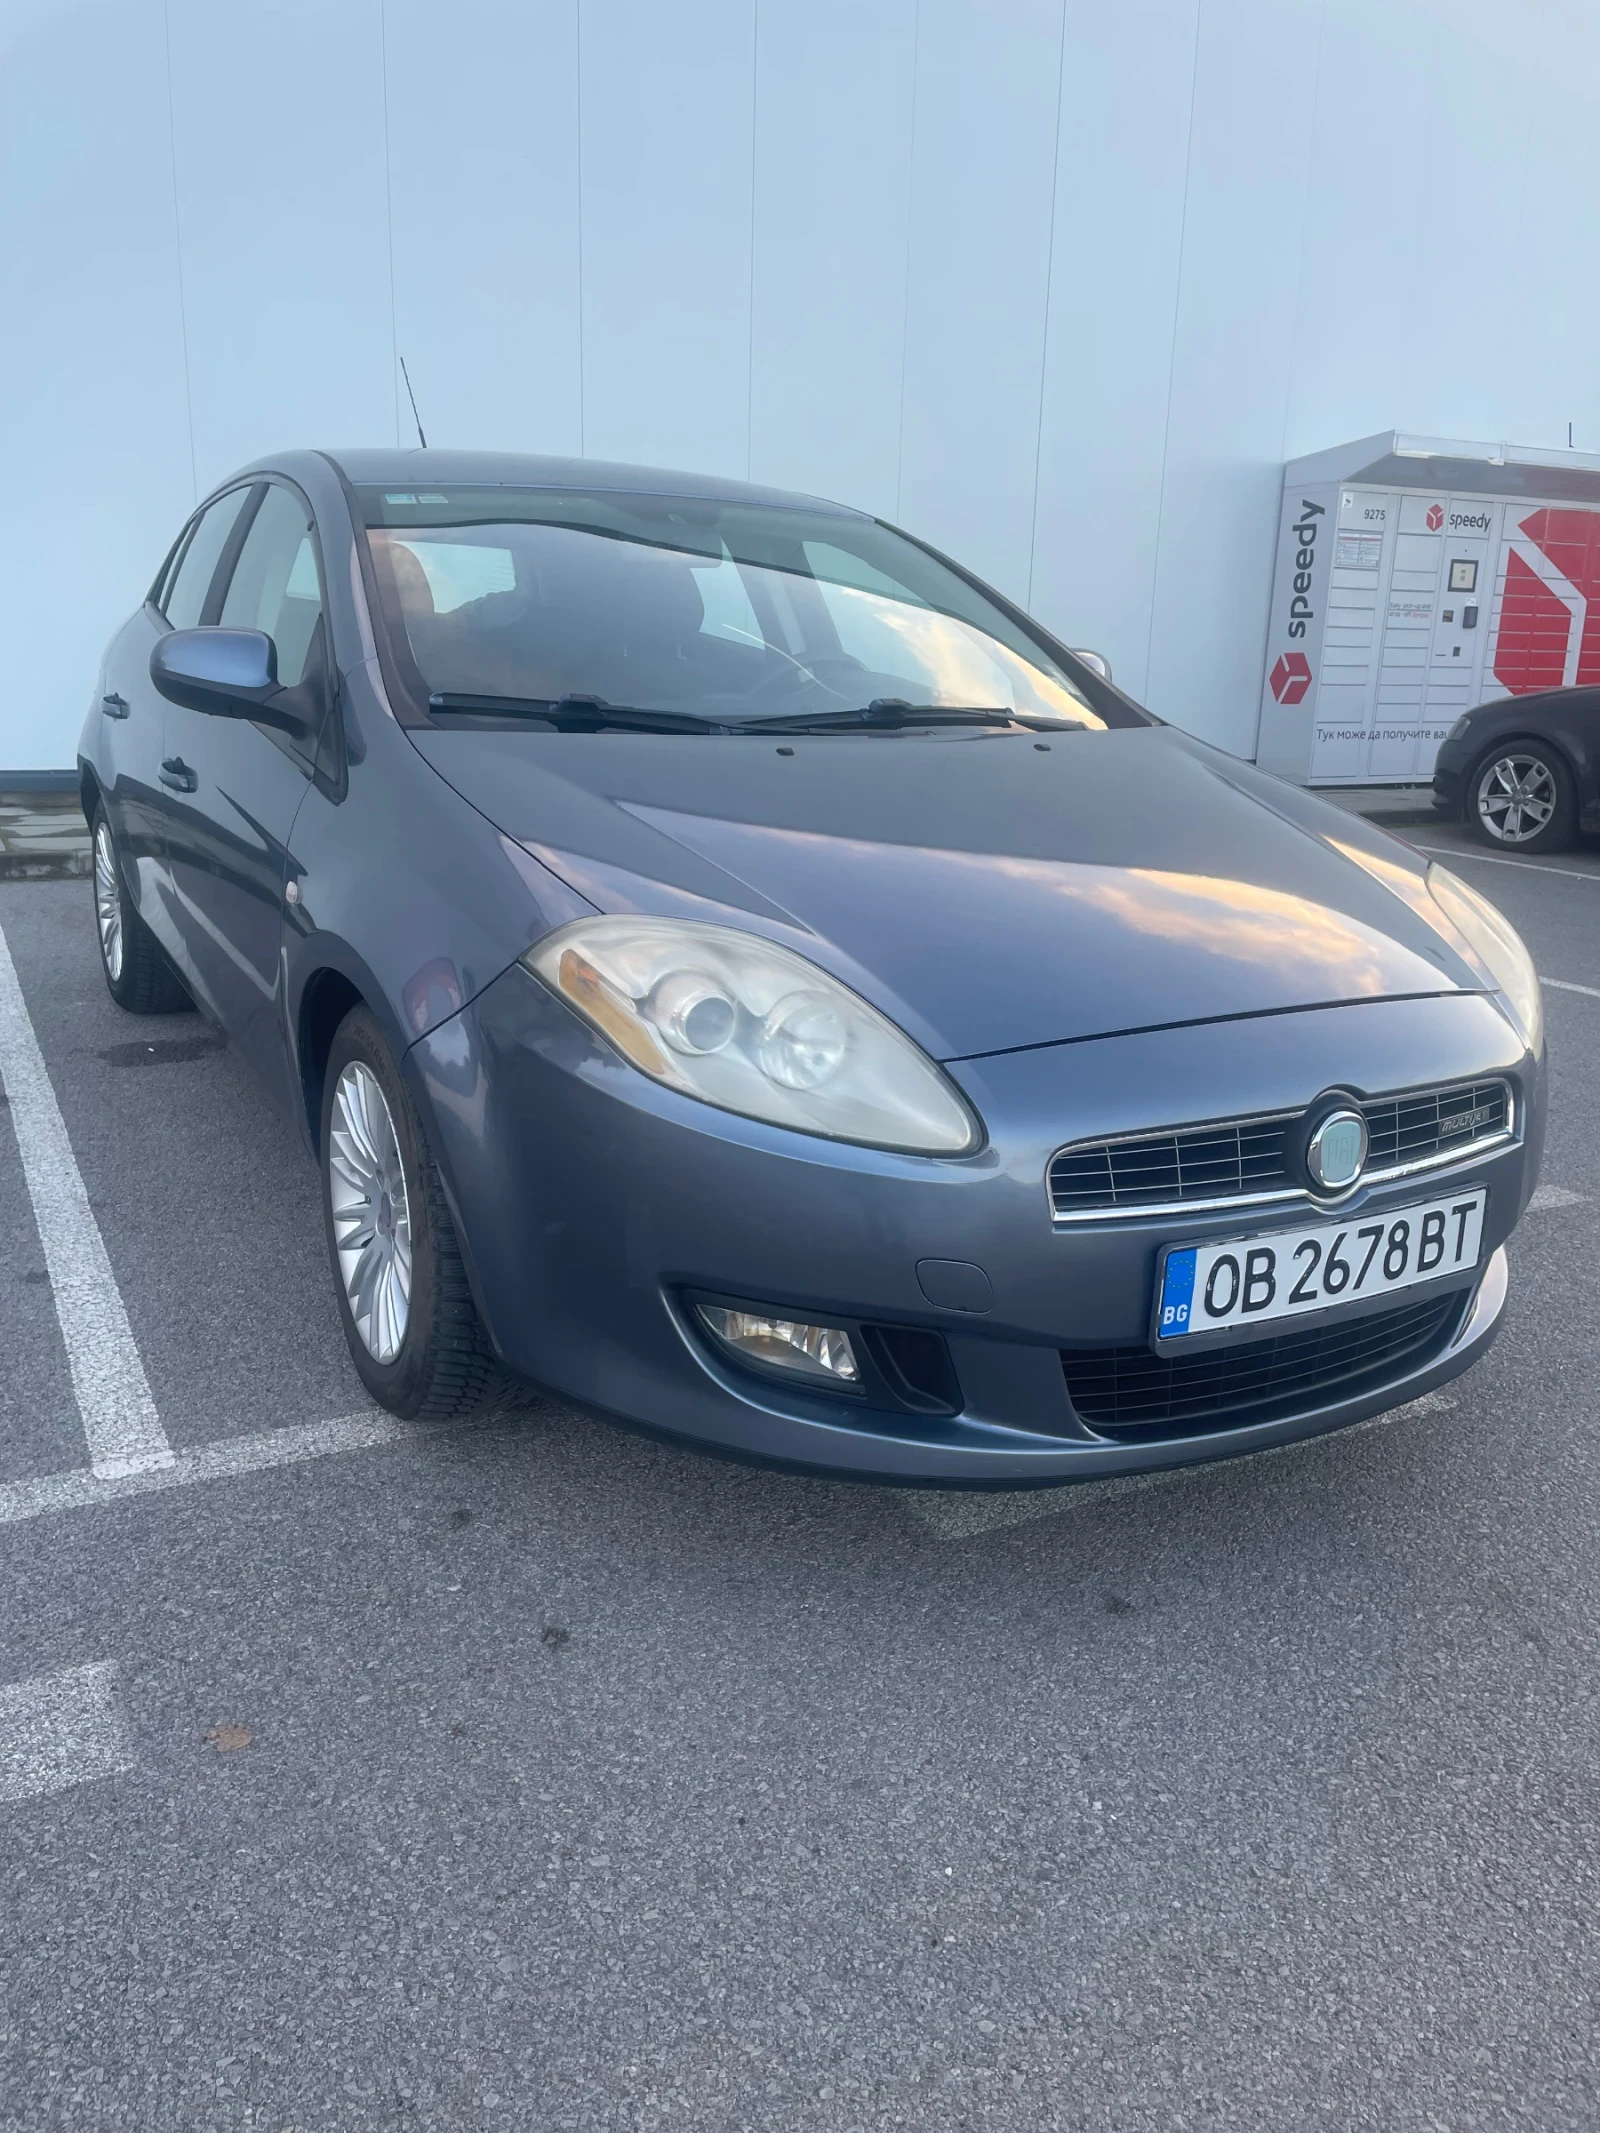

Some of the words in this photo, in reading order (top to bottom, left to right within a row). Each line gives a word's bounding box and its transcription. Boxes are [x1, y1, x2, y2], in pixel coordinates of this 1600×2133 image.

[1364, 508, 1386, 521] 9275
[1449, 513, 1491, 532] speedy
[1288, 499, 1325, 638] speedy
[1317, 729, 1334, 742] Тук
[1337, 729, 1366, 739] може
[1368, 730, 1380, 741] да
[1383, 729, 1431, 741] получите
[1327, 1136, 1356, 1169] FIAT
[1288, 1219, 1411, 1305] 2678
[1417, 1201, 1478, 1273] BT
[1163, 1304, 1188, 1325] BG
